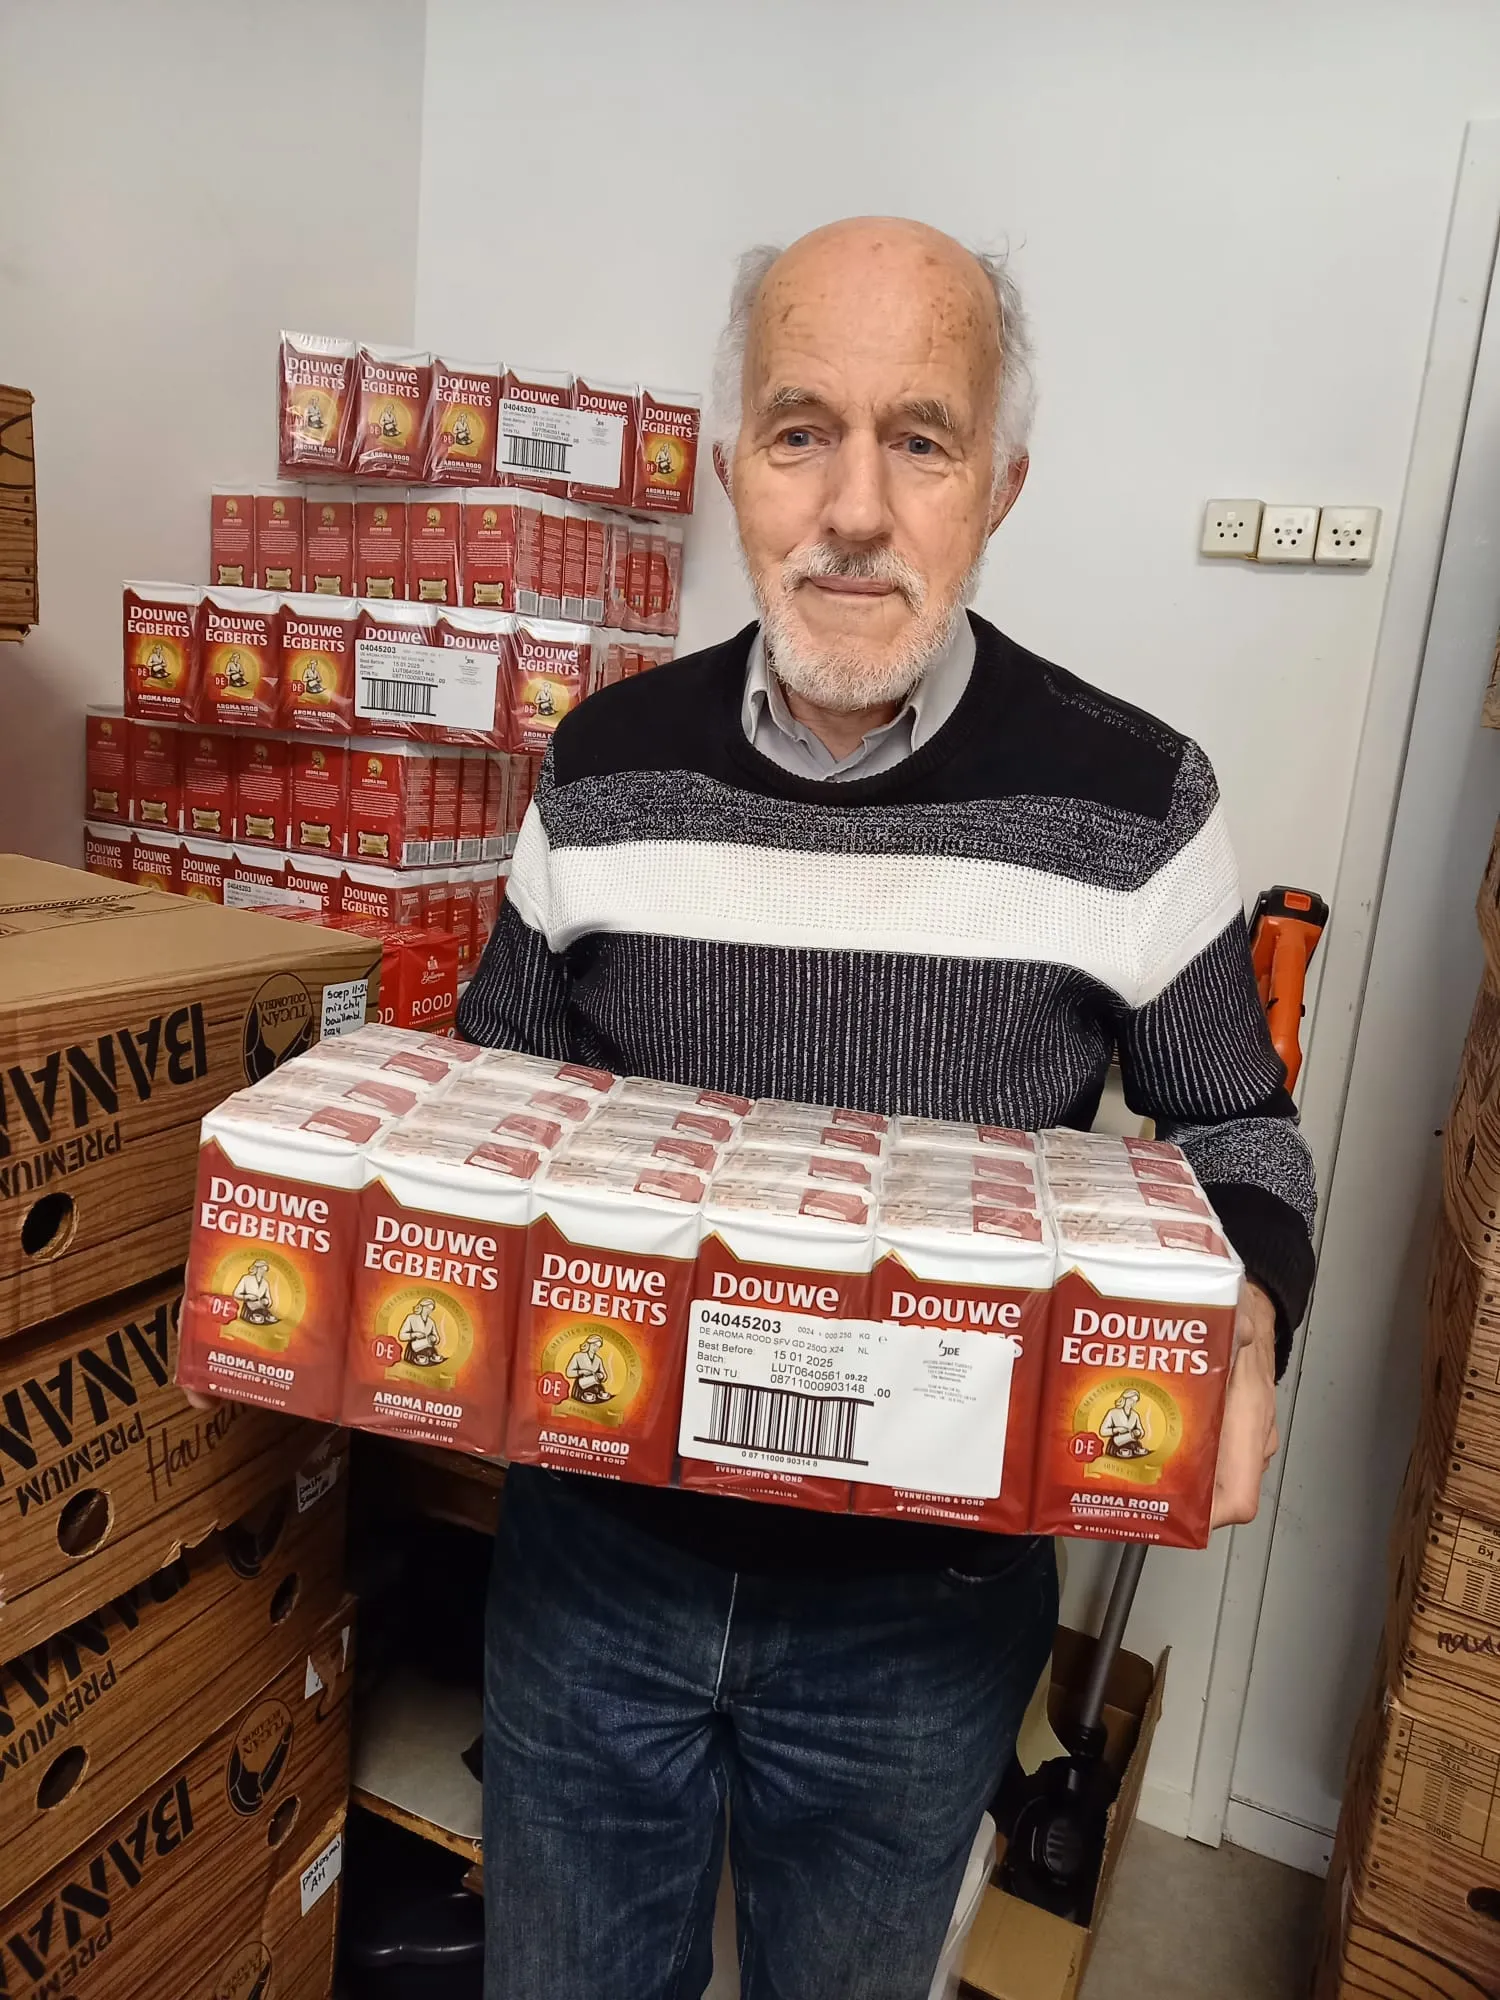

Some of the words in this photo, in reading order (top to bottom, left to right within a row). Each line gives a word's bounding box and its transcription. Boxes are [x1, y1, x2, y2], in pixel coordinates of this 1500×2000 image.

[361, 379, 420, 399] EGBERTS
[435, 388, 492, 407] EGBERTS
[503, 403, 537, 414] 04045203
[641, 419, 693, 438] EGBERTS
[127, 619, 190, 638] EGBERTS
[205, 628, 268, 647] EGBERTS
[282, 635, 345, 653] EGBERTS
[360, 643, 397, 654] 04045203
[517, 656, 580, 677] EGBERTS
[132, 859, 173, 876] EGBERTS
[180, 869, 222, 888] EGBERTS
[340, 898, 390, 919] EGBERTS
[411, 992, 453, 1018] ROOD
[0, 1001, 208, 1158] BANA
[200, 1201, 331, 1253] EGBERTS
[364, 1241, 499, 1291] EGBERTS
[531, 1279, 668, 1327] EGBERTS
[700, 1309, 782, 1334] 04045203
[698, 1339, 721, 1352] Best
[699, 1326, 711, 1336] DE
[712, 1328, 745, 1341] AROMA
[746, 1333, 772, 1345] ROOD
[773, 1336, 791, 1347] SFV
[806, 1342, 828, 1354] 250G
[857, 1346, 870, 1356] NL
[773, 1350, 787, 1360] 15
[789, 1351, 803, 1363] 01
[805, 1355, 834, 1368] 2025
[939, 1346, 961, 1358] JDE
[1060, 1335, 1209, 1375] EGBERTS
[208, 1351, 256, 1372] AROMA
[258, 1363, 295, 1382] ROOD
[208, 1365, 260, 1384] EVENWICHTIG
[695, 1364, 721, 1377] GTIN
[771, 1363, 841, 1381] LUT0640561
[844, 1373, 868, 1383] 09.22
[770, 1374, 866, 1394] 08711000903148
[873, 1387, 891, 1399] .00
[373, 1391, 422, 1412] AROMA
[424, 1399, 463, 1418] ROOD
[374, 1405, 426, 1424] EVENWICHTIG
[435, 1419, 458, 1429] ROND
[538, 1430, 589, 1449] AROMA
[591, 1439, 630, 1456] ROOD
[15, 1411, 145, 1517] PREMIUM
[540, 1445, 594, 1461] EVENWICHTIG
[603, 1456, 626, 1466] ROND
[741, 1451, 747, 1459] 0
[760, 1453, 785, 1464] 11000
[715, 1465, 771, 1480] EVENWICHTIG
[780, 1475, 803, 1484] ROND
[894, 1490, 951, 1504] EVENWICHTIG
[961, 1498, 985, 1507] ROND
[1070, 1493, 1125, 1507] AROMA
[1128, 1498, 1170, 1513] ROOD
[1072, 1506, 1130, 1519] EVENWICHTIG
[1141, 1513, 1165, 1522] ROND
[1085, 1525, 1160, 1540] SNELFILTERMALING
[0, 1775, 194, 2000] BANA
